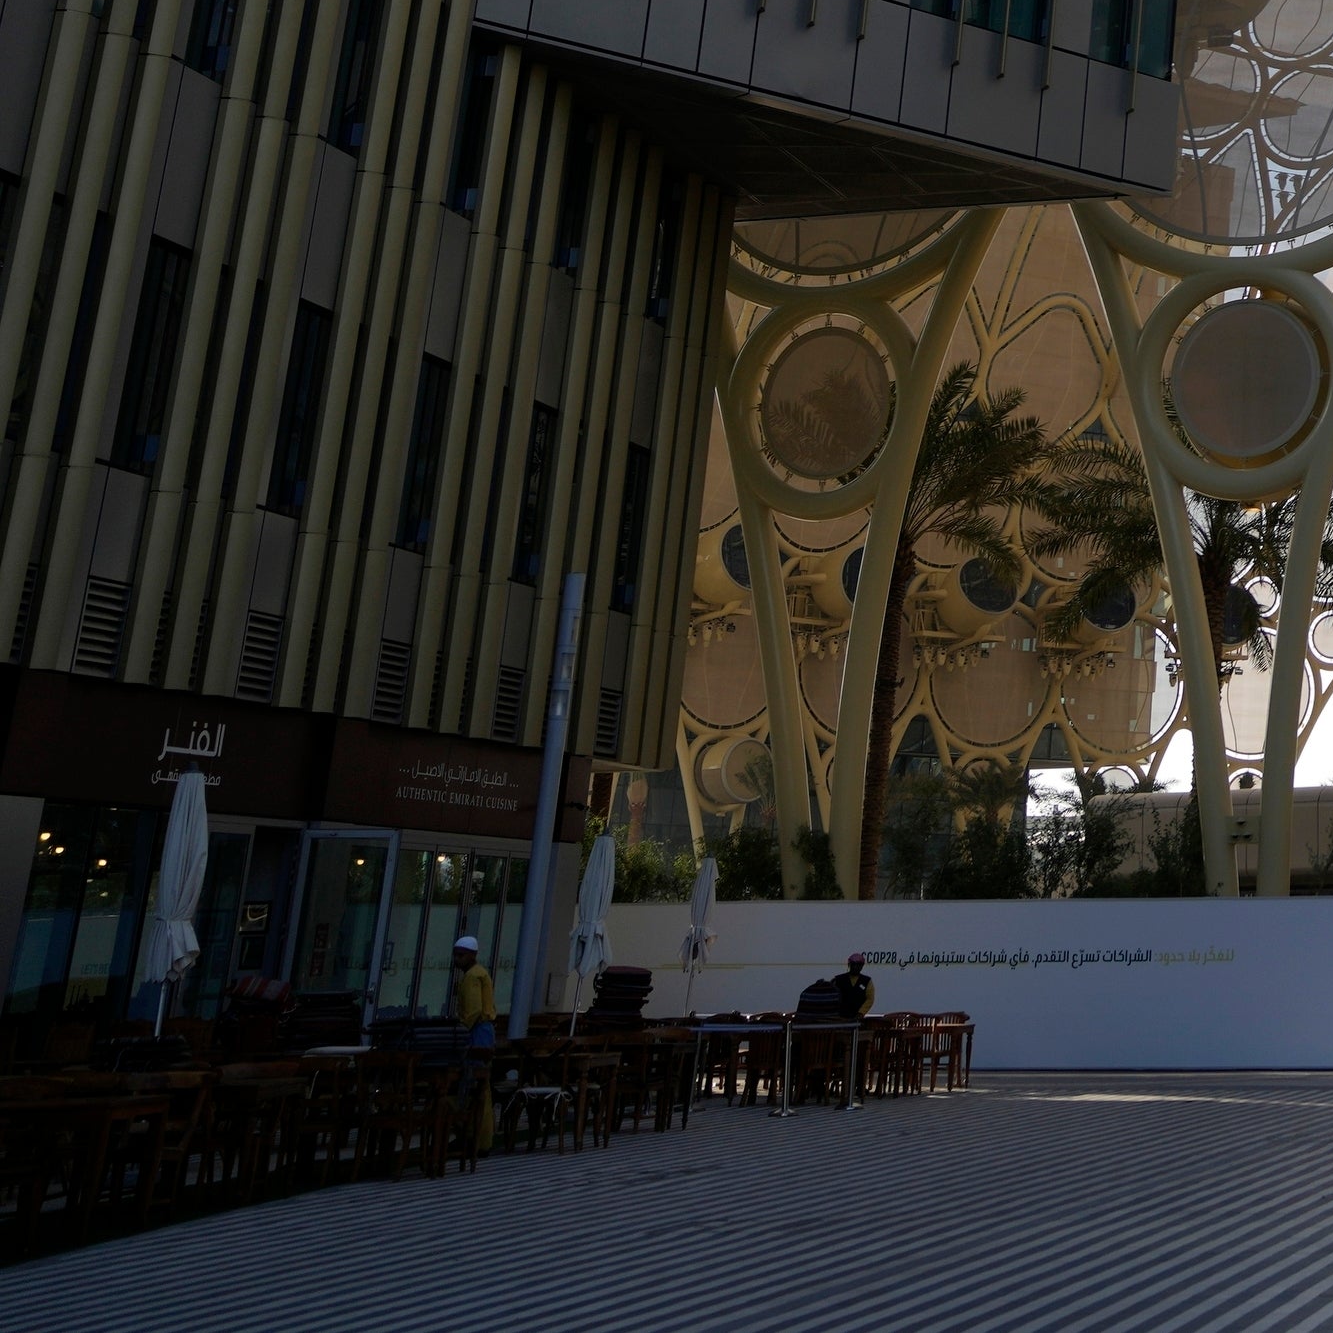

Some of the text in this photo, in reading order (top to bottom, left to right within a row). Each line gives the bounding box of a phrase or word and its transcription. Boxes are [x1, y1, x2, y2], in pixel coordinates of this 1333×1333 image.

[157, 721, 226, 762] الفنر
[395, 786, 518, 811] AUTHENTIC EMIRATI CUISINE
[898, 952, 915, 970] في
[917, 951, 965, 968] ستبنونها
[967, 948, 1007, 968] شراكات
[1009, 947, 1030, 970] فأي
[1102, 947, 1152, 966] الشراكات
